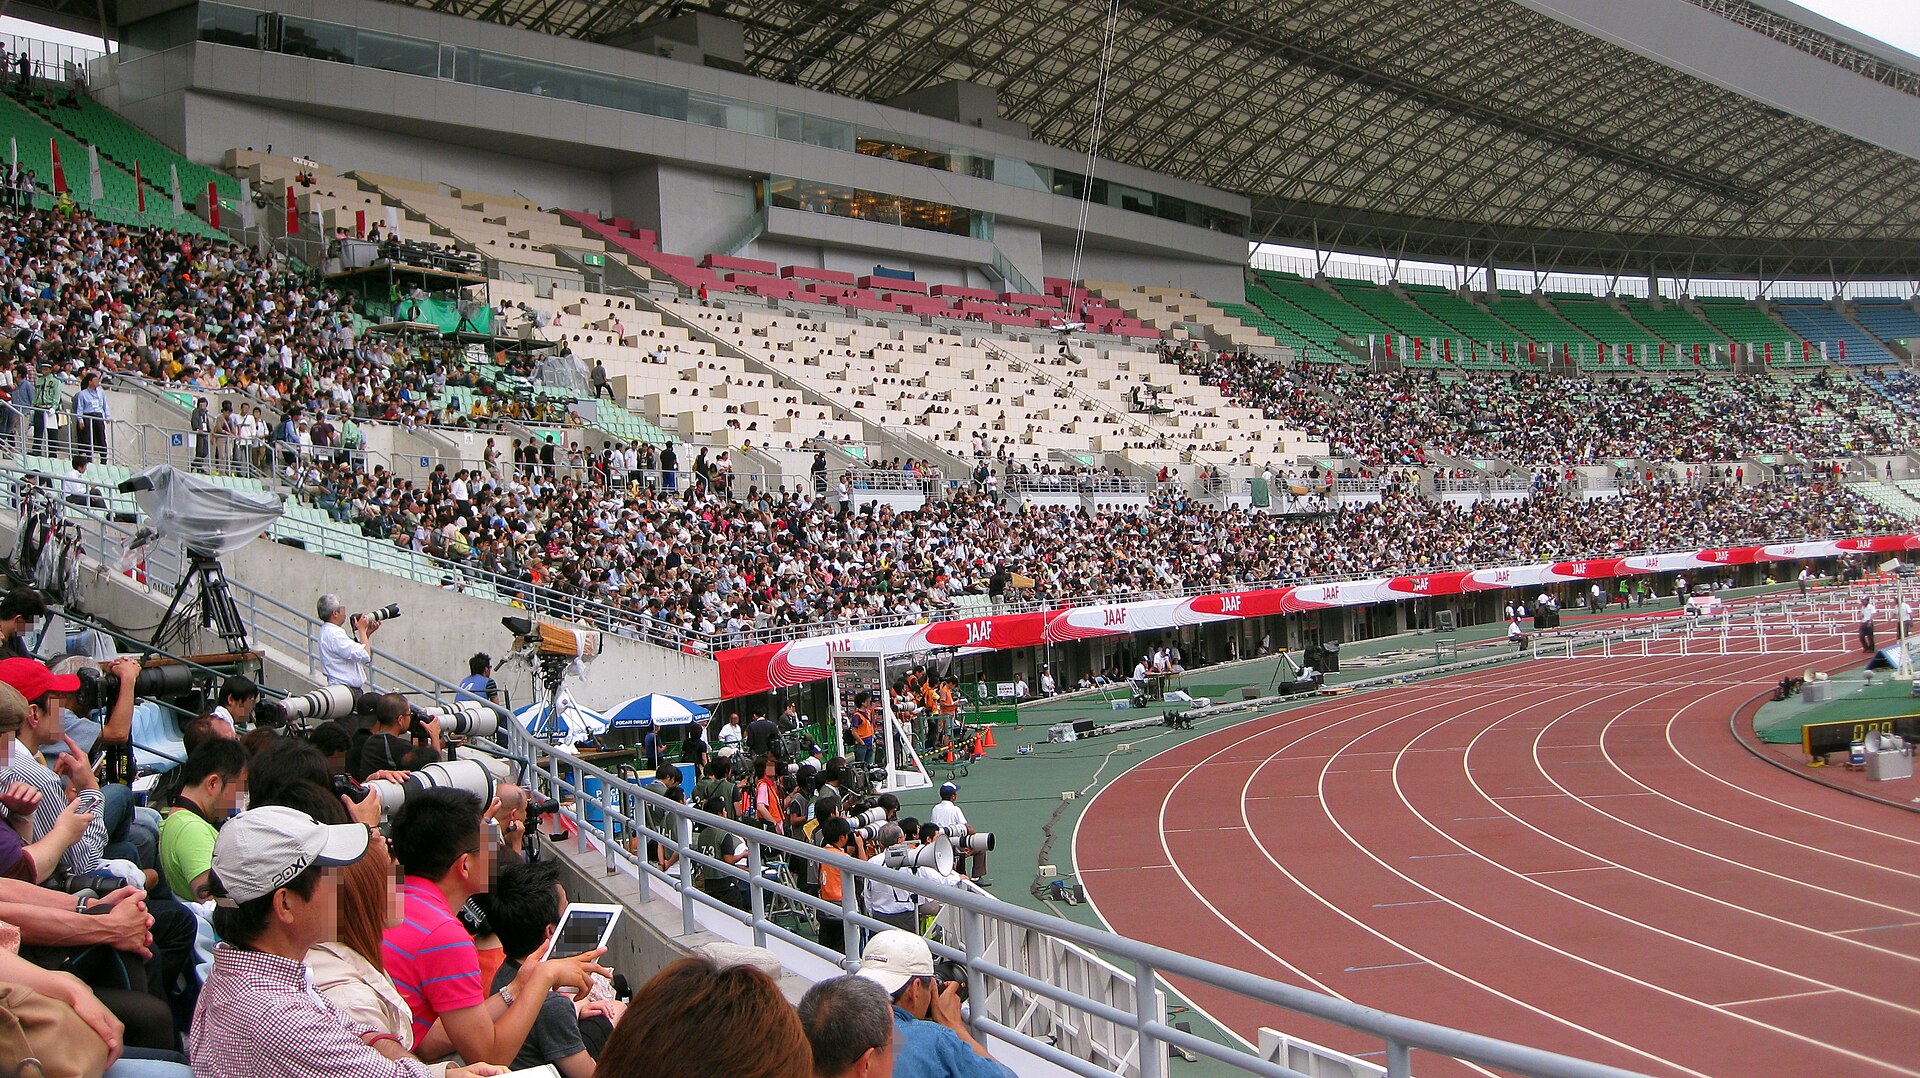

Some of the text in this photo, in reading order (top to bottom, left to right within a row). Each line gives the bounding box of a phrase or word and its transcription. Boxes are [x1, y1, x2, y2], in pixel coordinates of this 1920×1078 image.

[1856, 540, 1872, 549] JAAF
[1714, 551, 1729, 562] JAAF
[1572, 562, 1587, 575] JAAF
[1495, 570, 1510, 582] JAAF
[1322, 586, 1339, 600] JAAF
[1221, 596, 1241, 612] JAAF
[1103, 608, 1127, 626] JAAF
[965, 620, 992, 644] JAAF
[701, 845, 715, 858] 7-3
